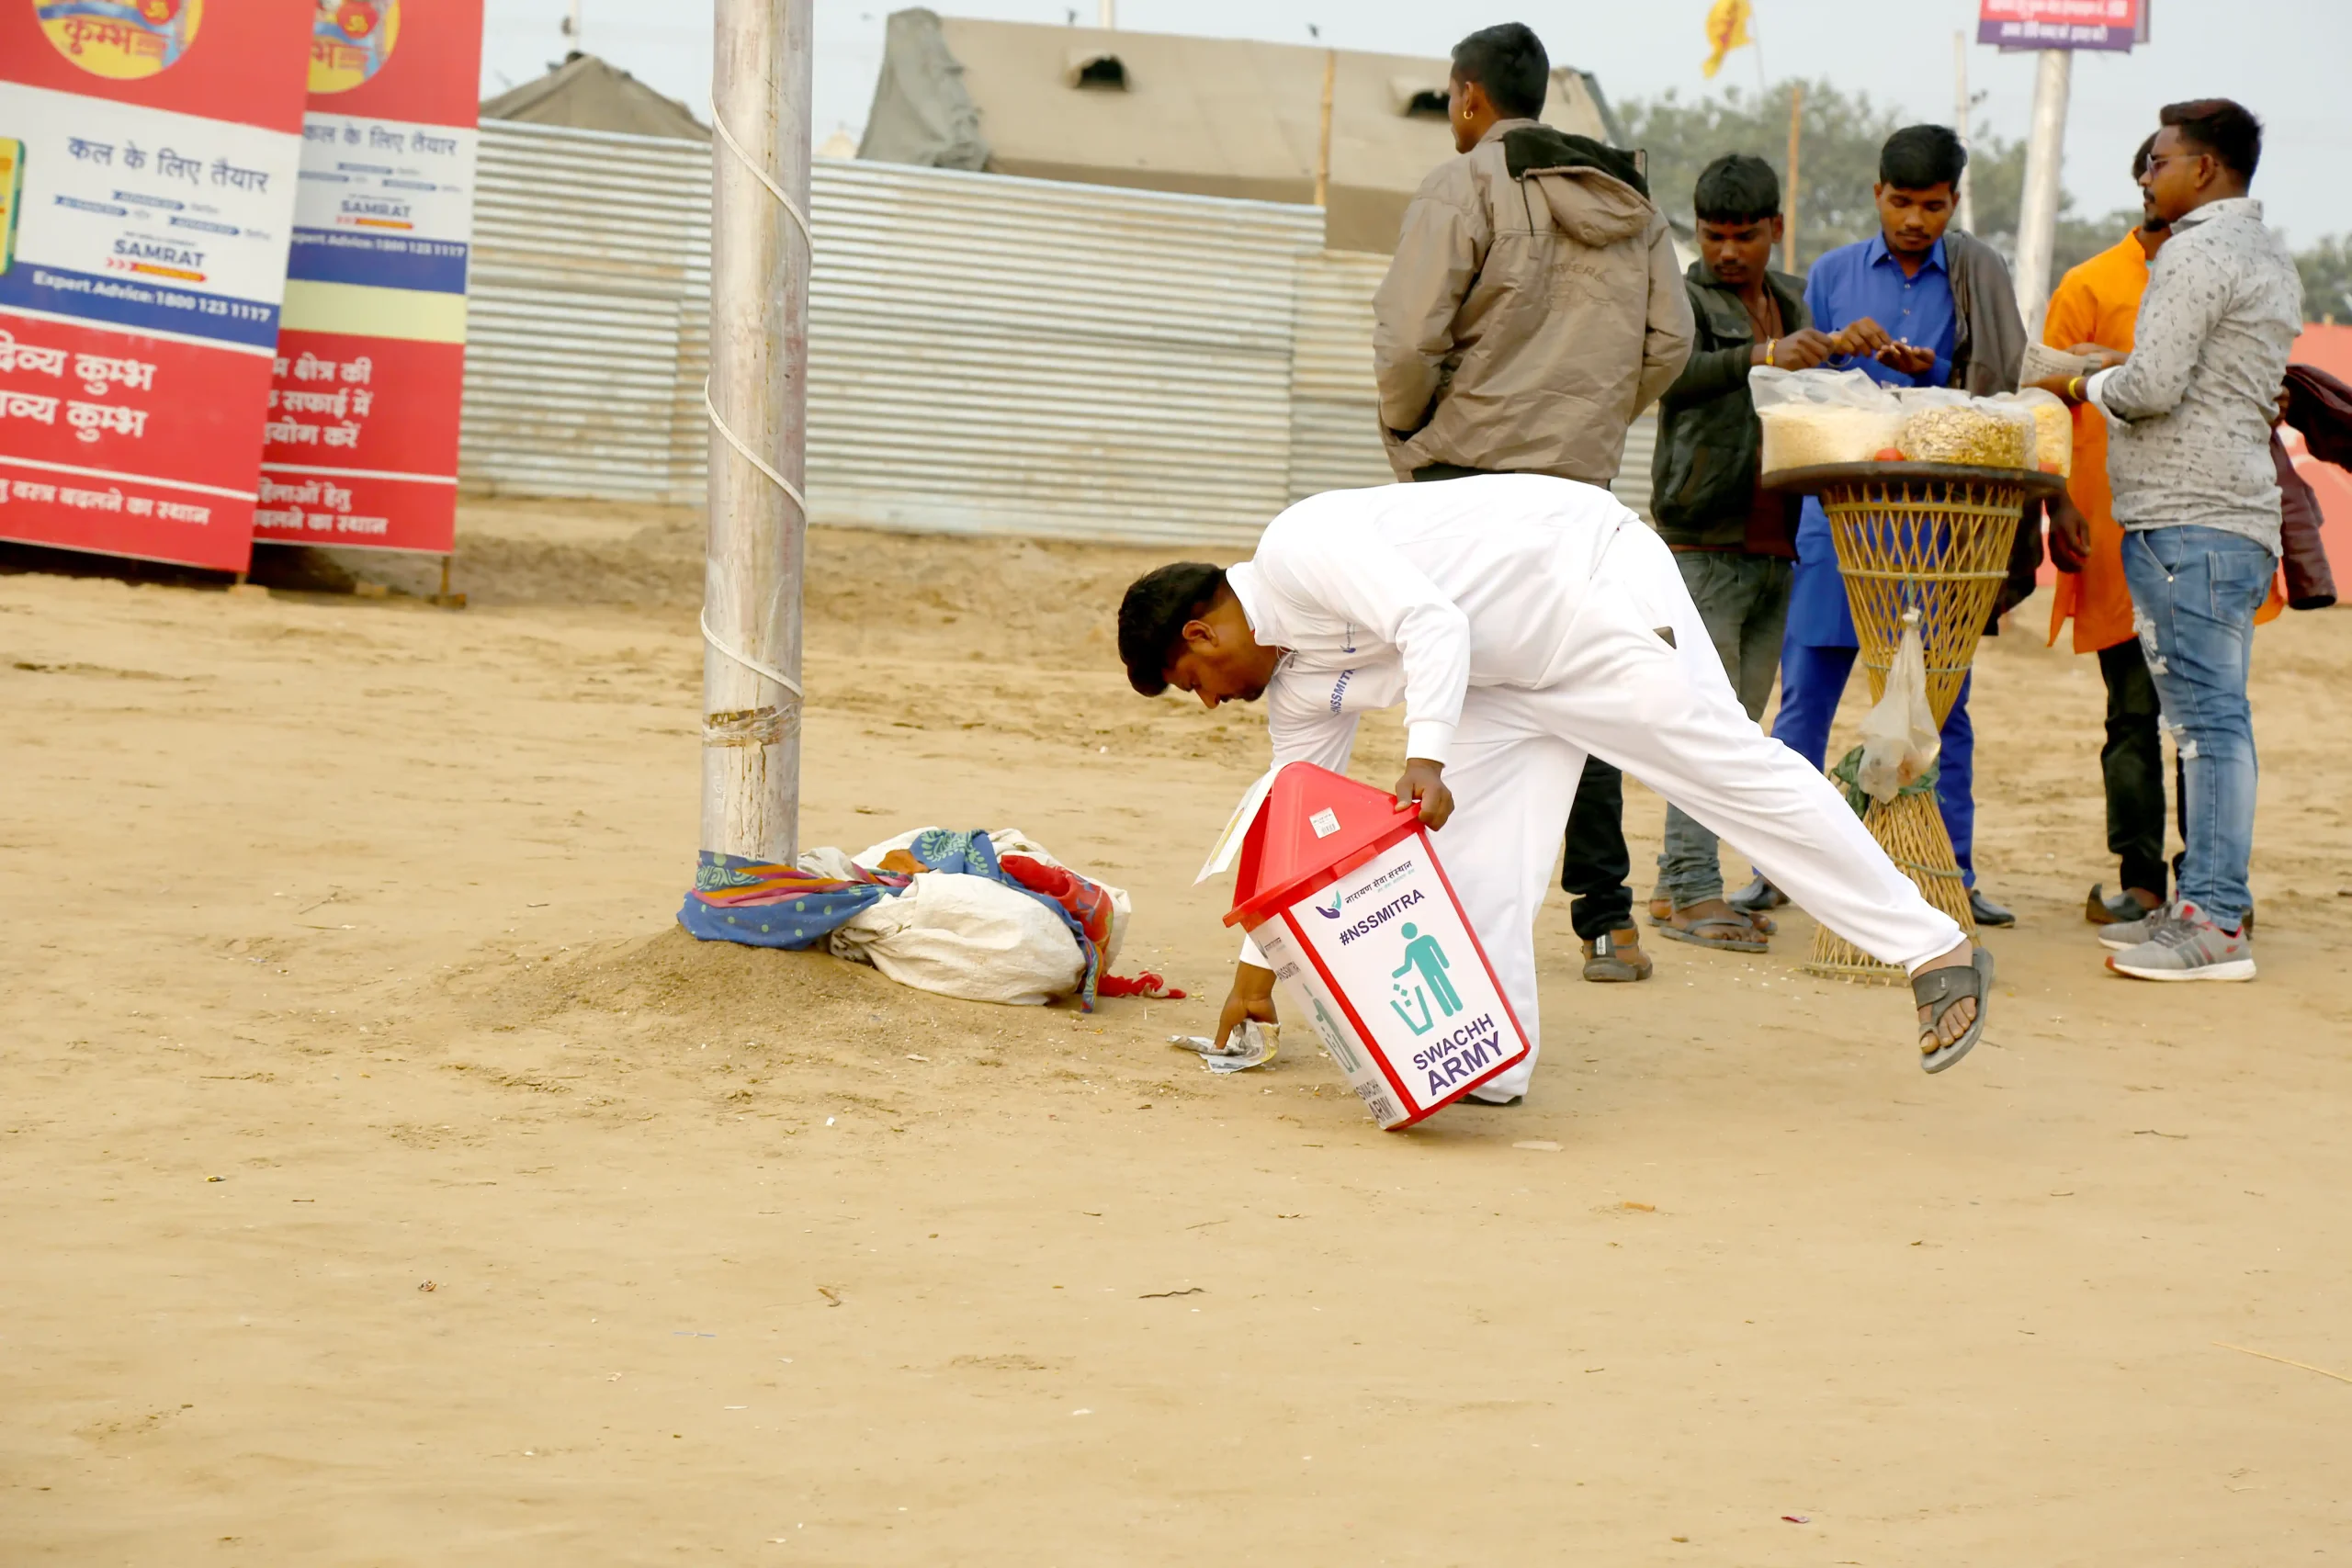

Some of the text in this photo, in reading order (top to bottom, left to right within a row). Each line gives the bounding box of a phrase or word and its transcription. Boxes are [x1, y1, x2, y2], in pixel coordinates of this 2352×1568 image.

[68, 137, 269, 194] कल के लिए तैयार
[114, 239, 206, 268] SAMRAT
[74, 353, 157, 396] कुम्भ
[66, 400, 149, 443] कुम्भ
[1345, 884, 1373, 904] नारायण
[1373, 874, 1388, 888] सेवा
[1387, 860, 1412, 880] संस्थान
[1340, 889, 1425, 946] #NSSMITRA
[1413, 1013, 1494, 1070] SWACHH
[1429, 1031, 1502, 1097] ARMY
[1368, 1095, 1397, 1123] ARMY
